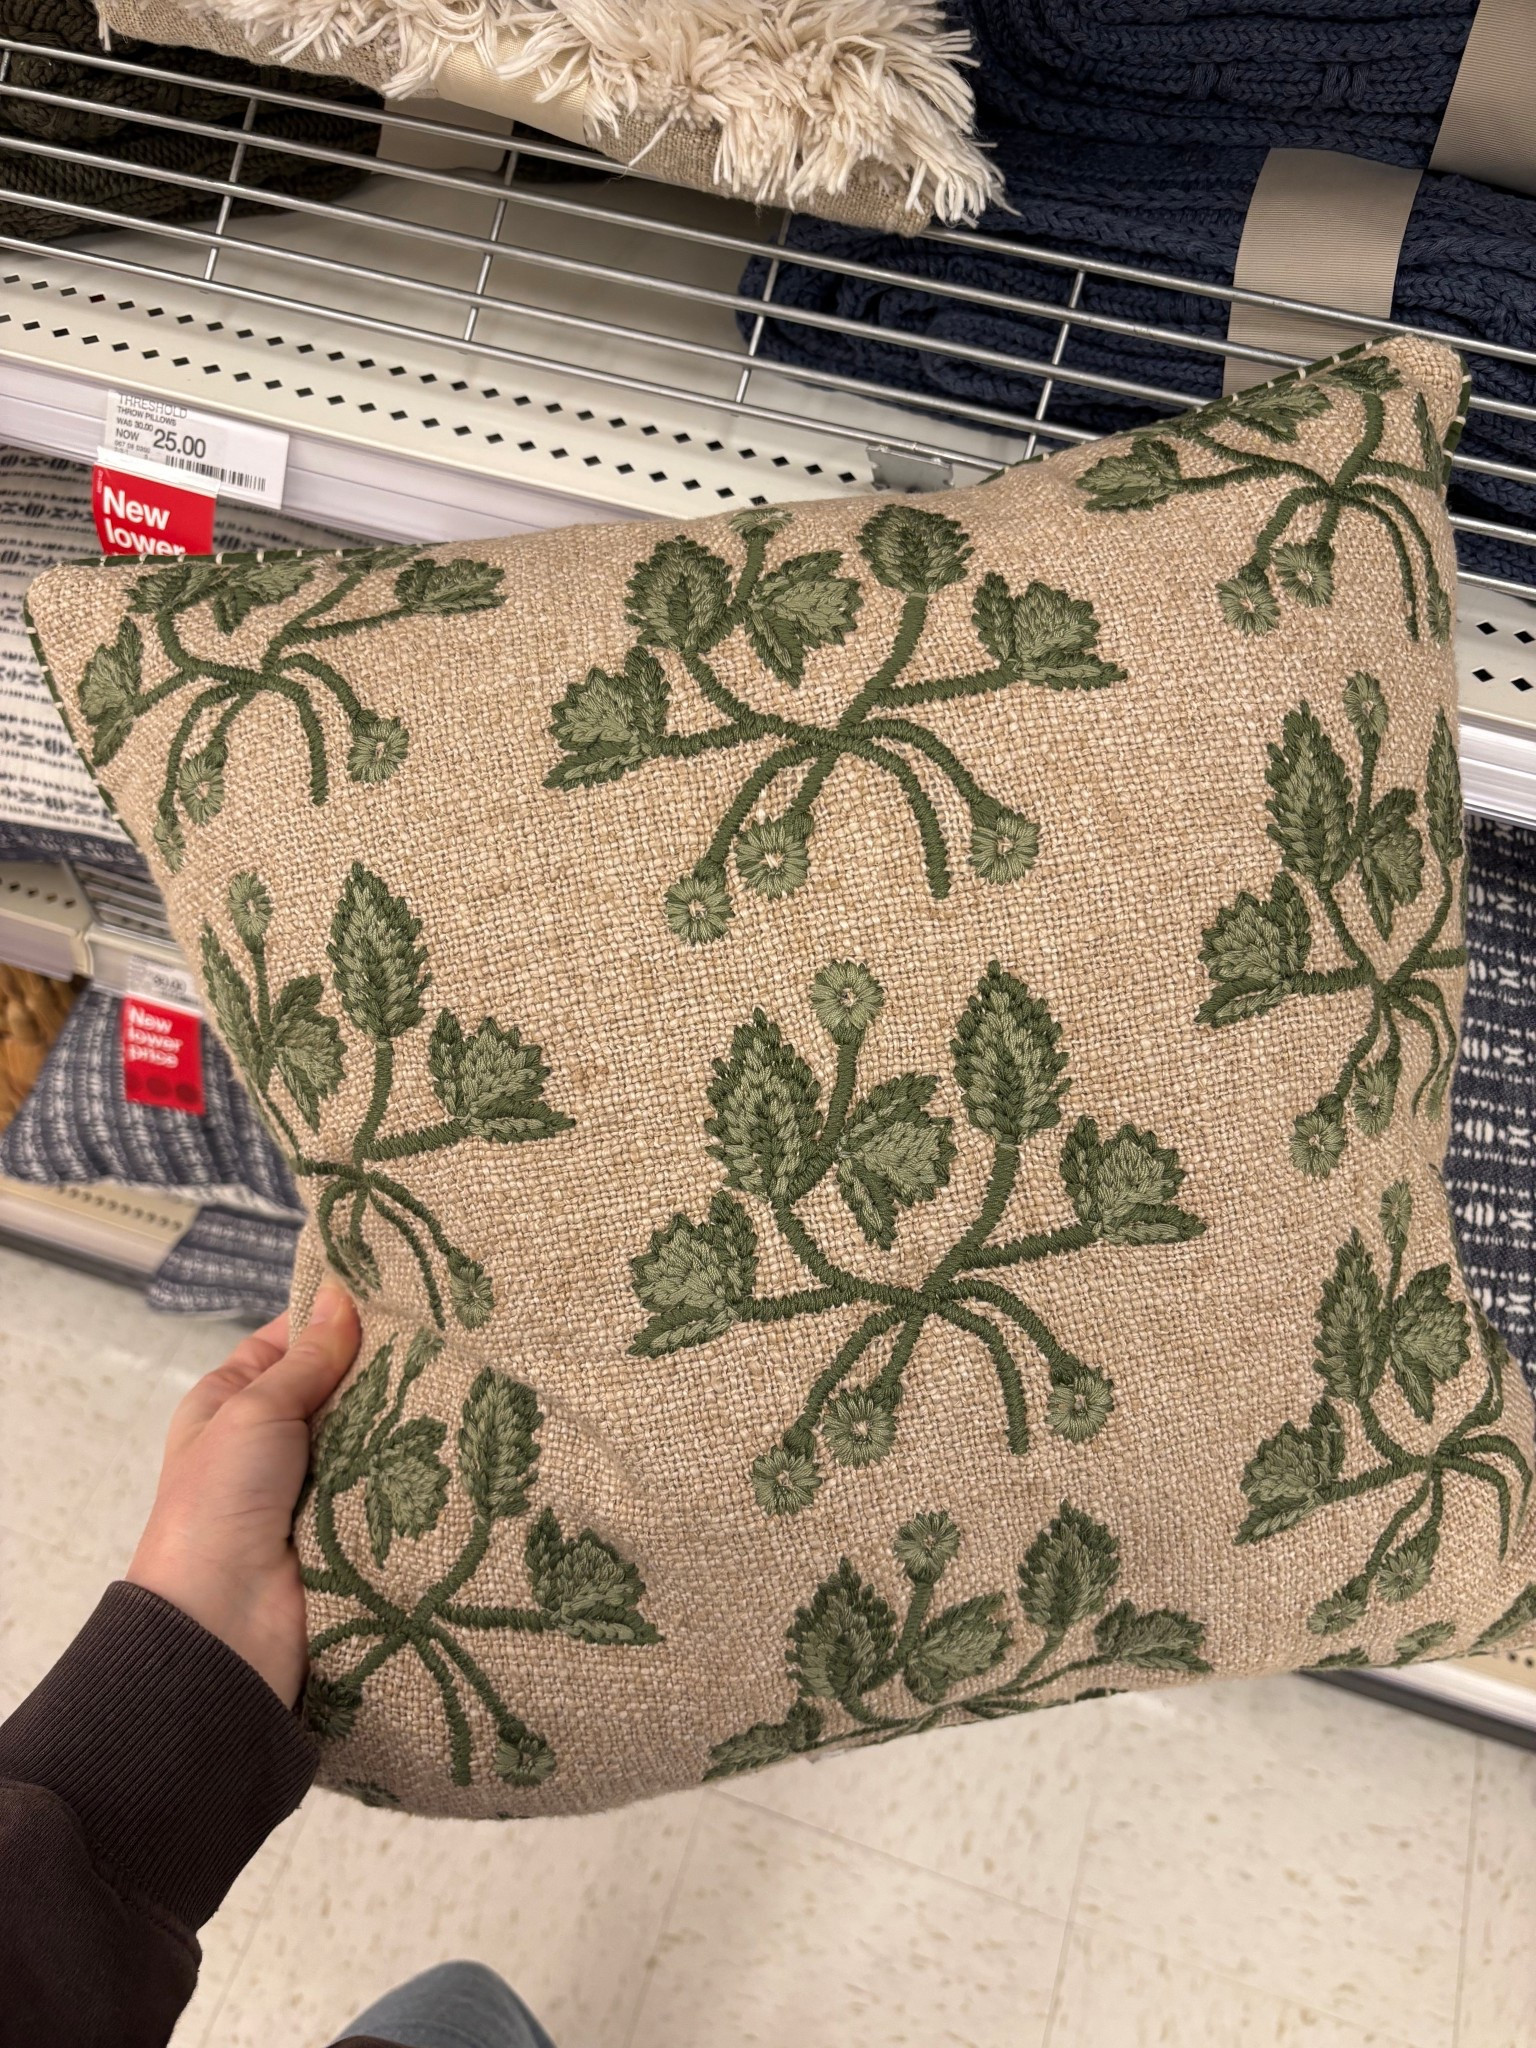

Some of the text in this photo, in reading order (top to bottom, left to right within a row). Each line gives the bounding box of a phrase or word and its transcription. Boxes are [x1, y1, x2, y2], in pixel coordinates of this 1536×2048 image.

[117, 406, 177, 426] THROW PILLOWS
[119, 395, 187, 419] THRESHOLD
[117, 417, 154, 432] WAS 30.00
[115, 428, 140, 441] NOW
[153, 429, 206, 458] 25.00
[103, 485, 171, 530] New
[104, 518, 186, 555] lower
[127, 1004, 173, 1034] New
[127, 1026, 183, 1053] lower
[127, 1044, 179, 1068] price
